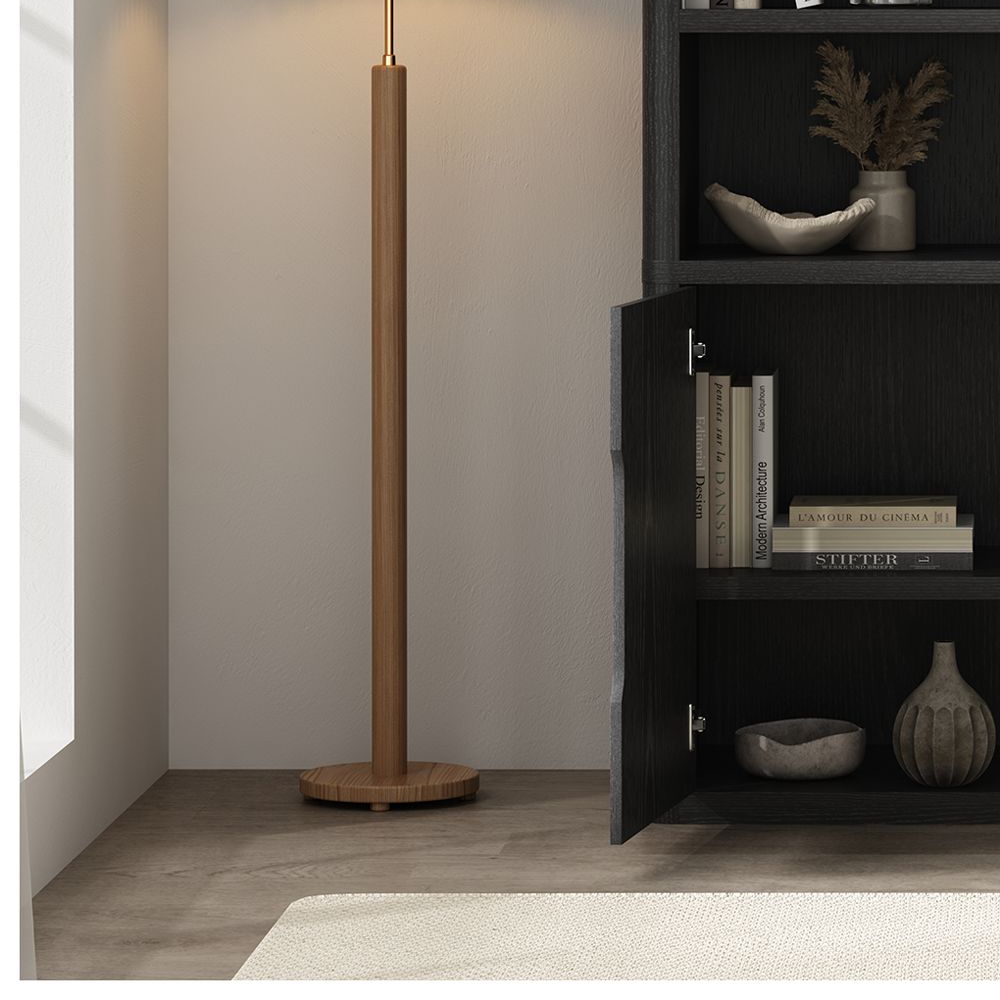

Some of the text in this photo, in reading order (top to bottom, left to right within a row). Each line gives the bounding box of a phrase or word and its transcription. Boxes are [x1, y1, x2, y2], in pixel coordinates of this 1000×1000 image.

[696, 416, 705, 519] Editorial Design
[715, 472, 725, 545] DANSE
[756, 461, 767, 560] Modern Architecture
[798, 513, 853, 522] L'AMOUR
[882, 512, 928, 522] CINÉMA
[816, 554, 898, 565] STIFTER
